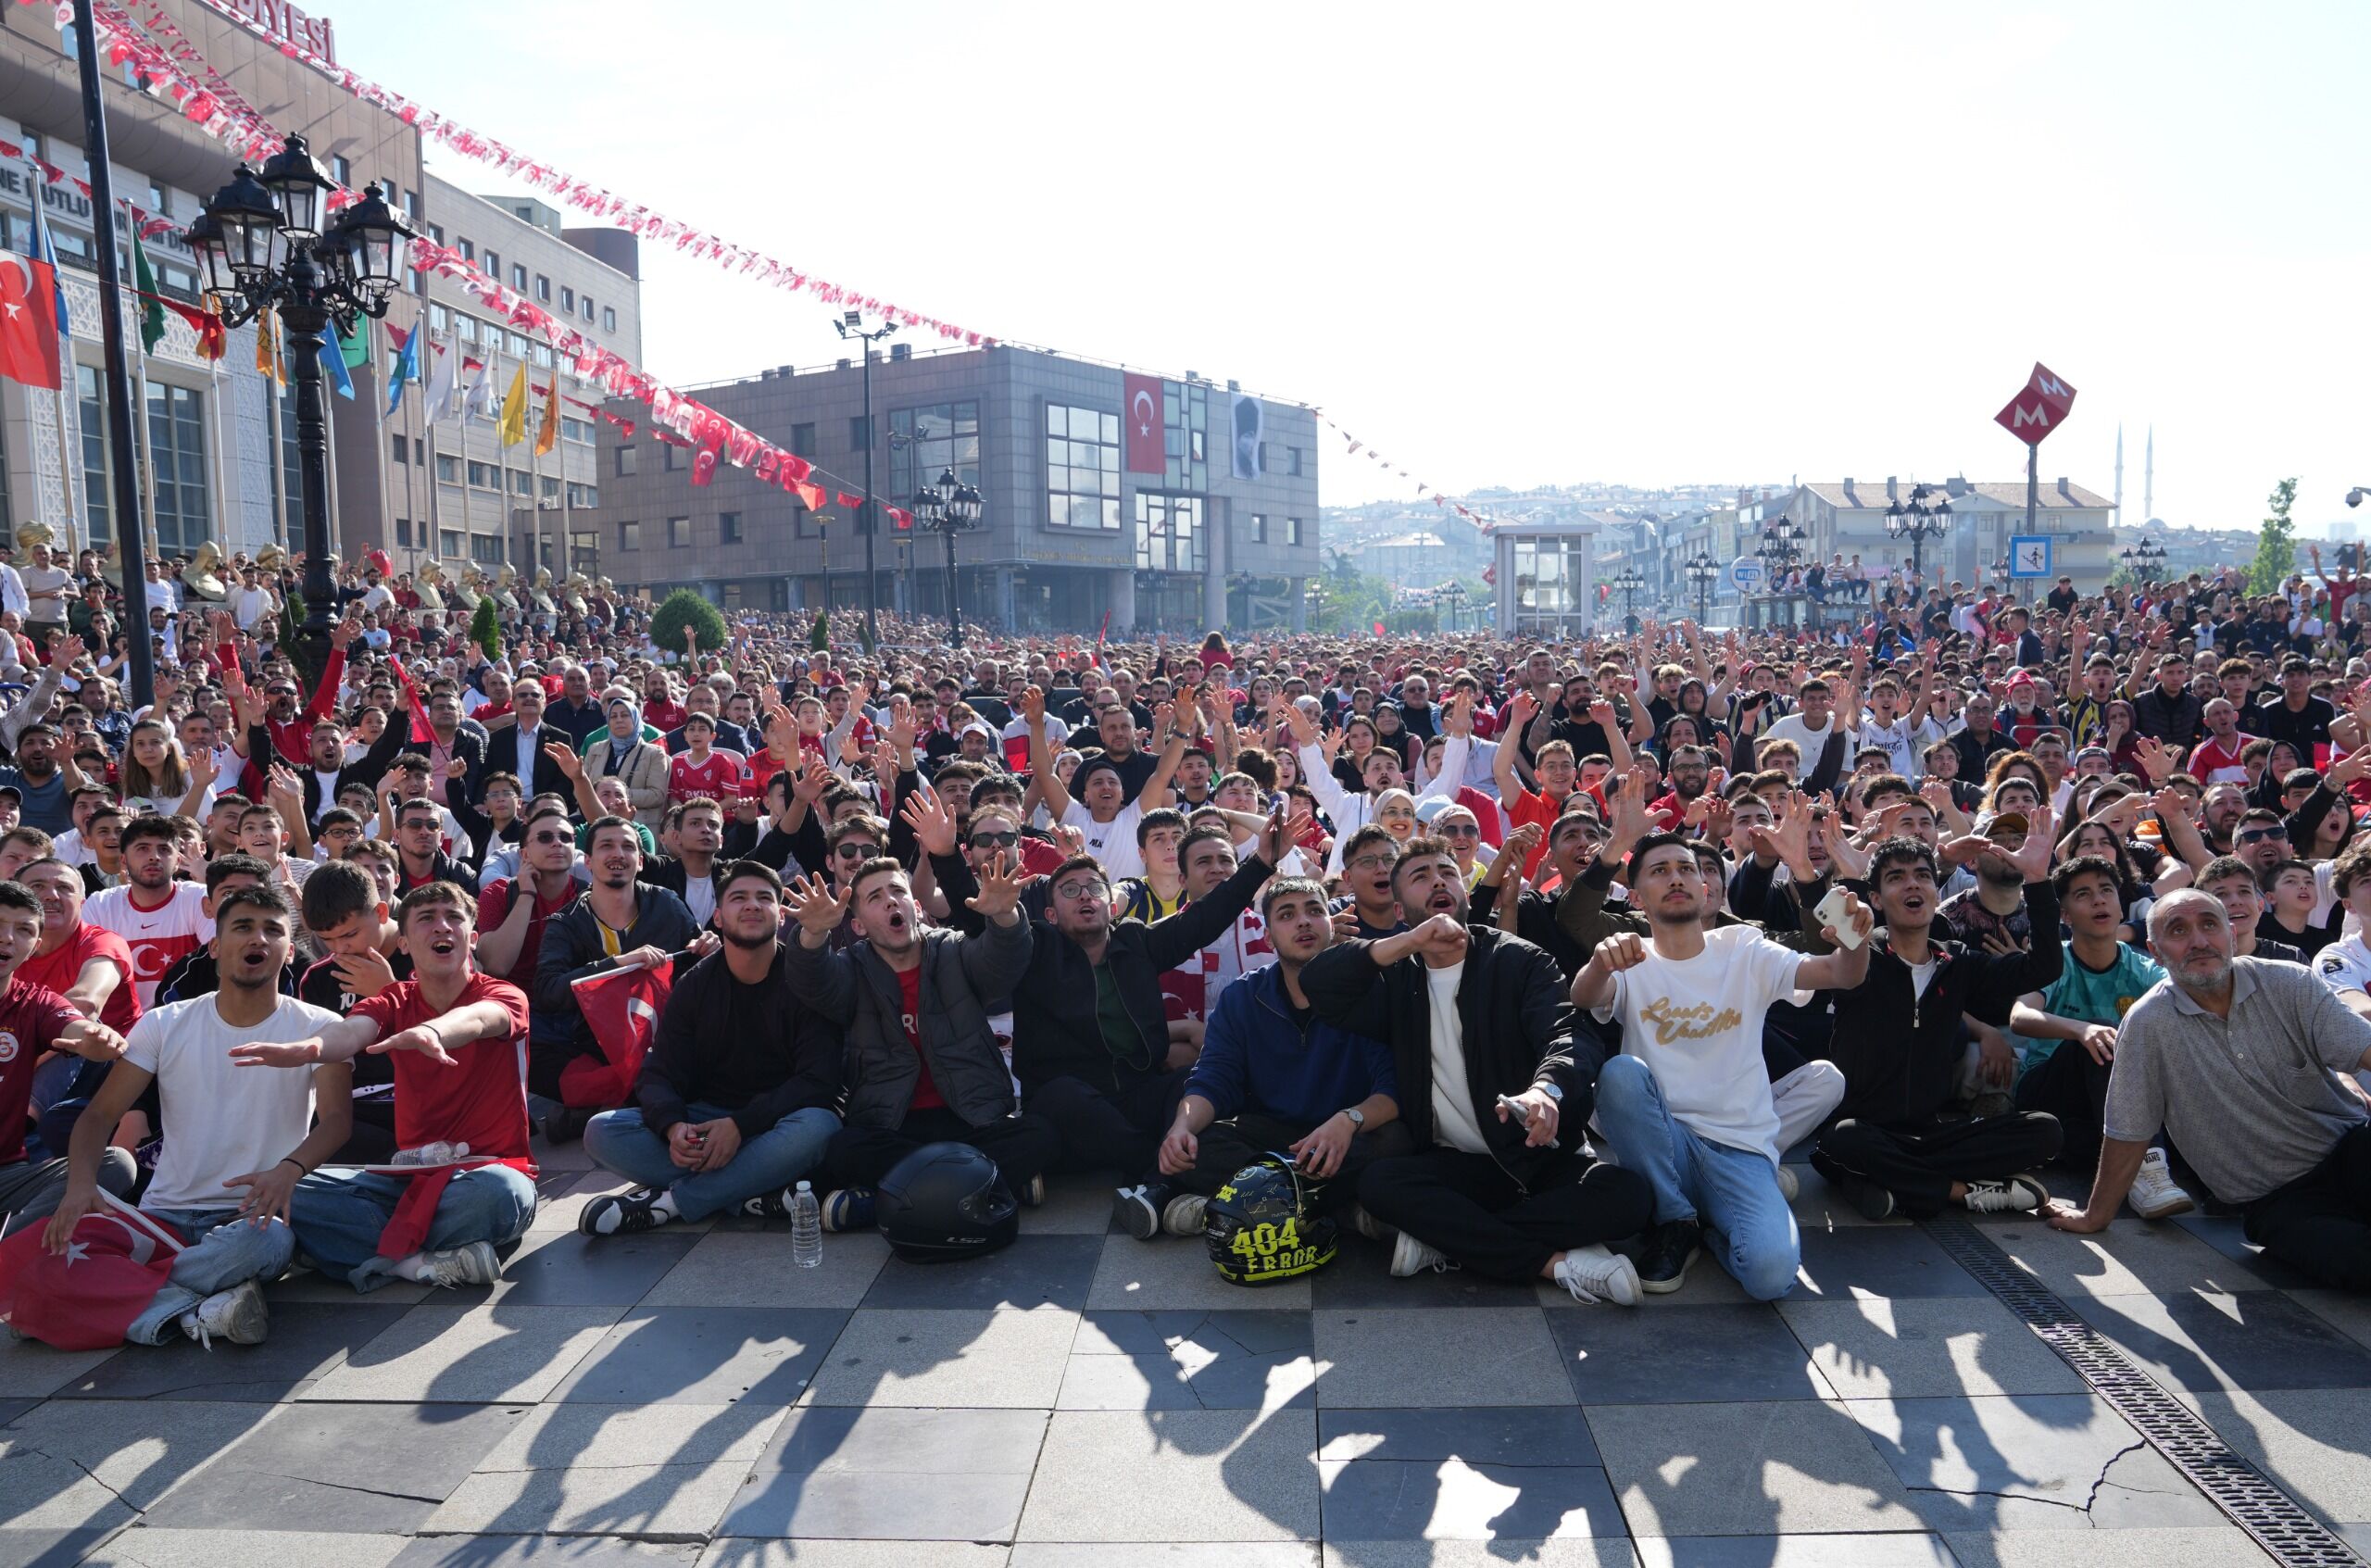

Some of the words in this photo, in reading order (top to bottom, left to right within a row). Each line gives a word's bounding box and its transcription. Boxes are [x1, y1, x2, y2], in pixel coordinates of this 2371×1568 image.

[2038, 374, 2069, 397] M
[2013, 402, 2050, 428] M
[340, 992, 357, 1010] 10
[1228, 1217, 1300, 1258] 404
